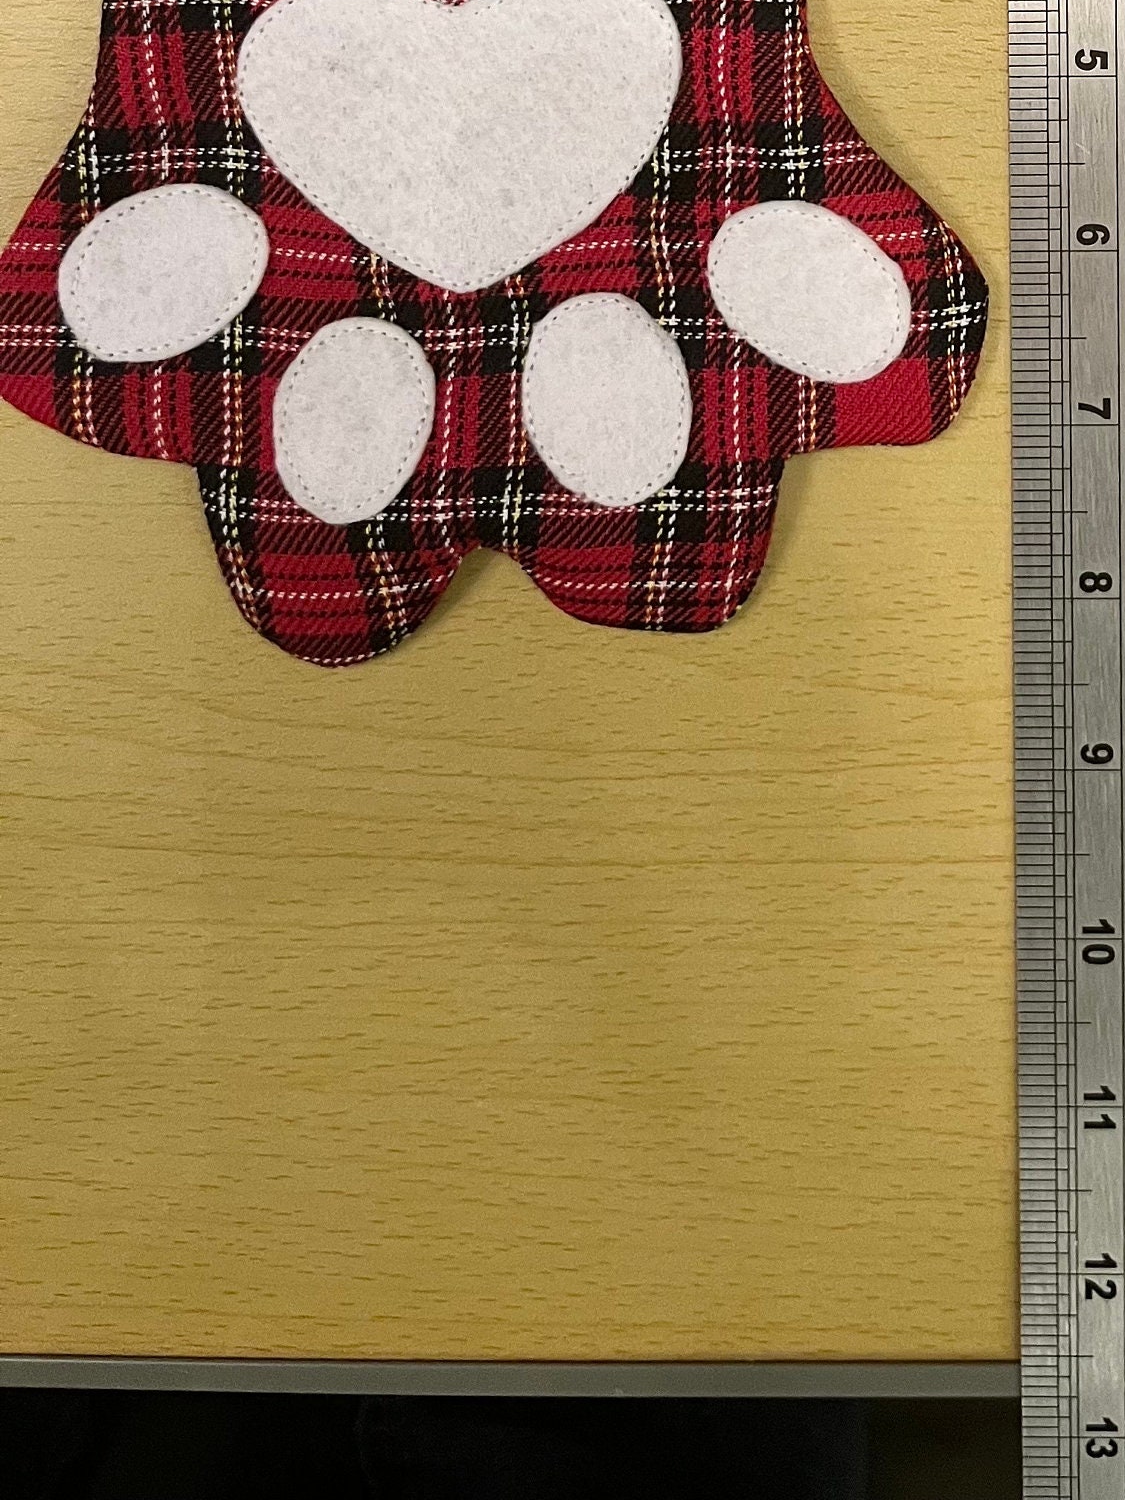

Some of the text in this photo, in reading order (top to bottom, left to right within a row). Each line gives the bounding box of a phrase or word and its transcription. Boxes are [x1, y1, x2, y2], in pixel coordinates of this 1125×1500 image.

[1074, 49, 1108, 71] 5
[1076, 223, 1110, 246] 6
[1077, 397, 1111, 420] 7
[1079, 571, 1113, 594] 8
[1080, 743, 1114, 765] 9
[1082, 918, 1116, 966] 10
[1083, 1085, 1117, 1130] 11
[1084, 1252, 1118, 1301] 12
[1085, 1416, 1119, 1459] 13
